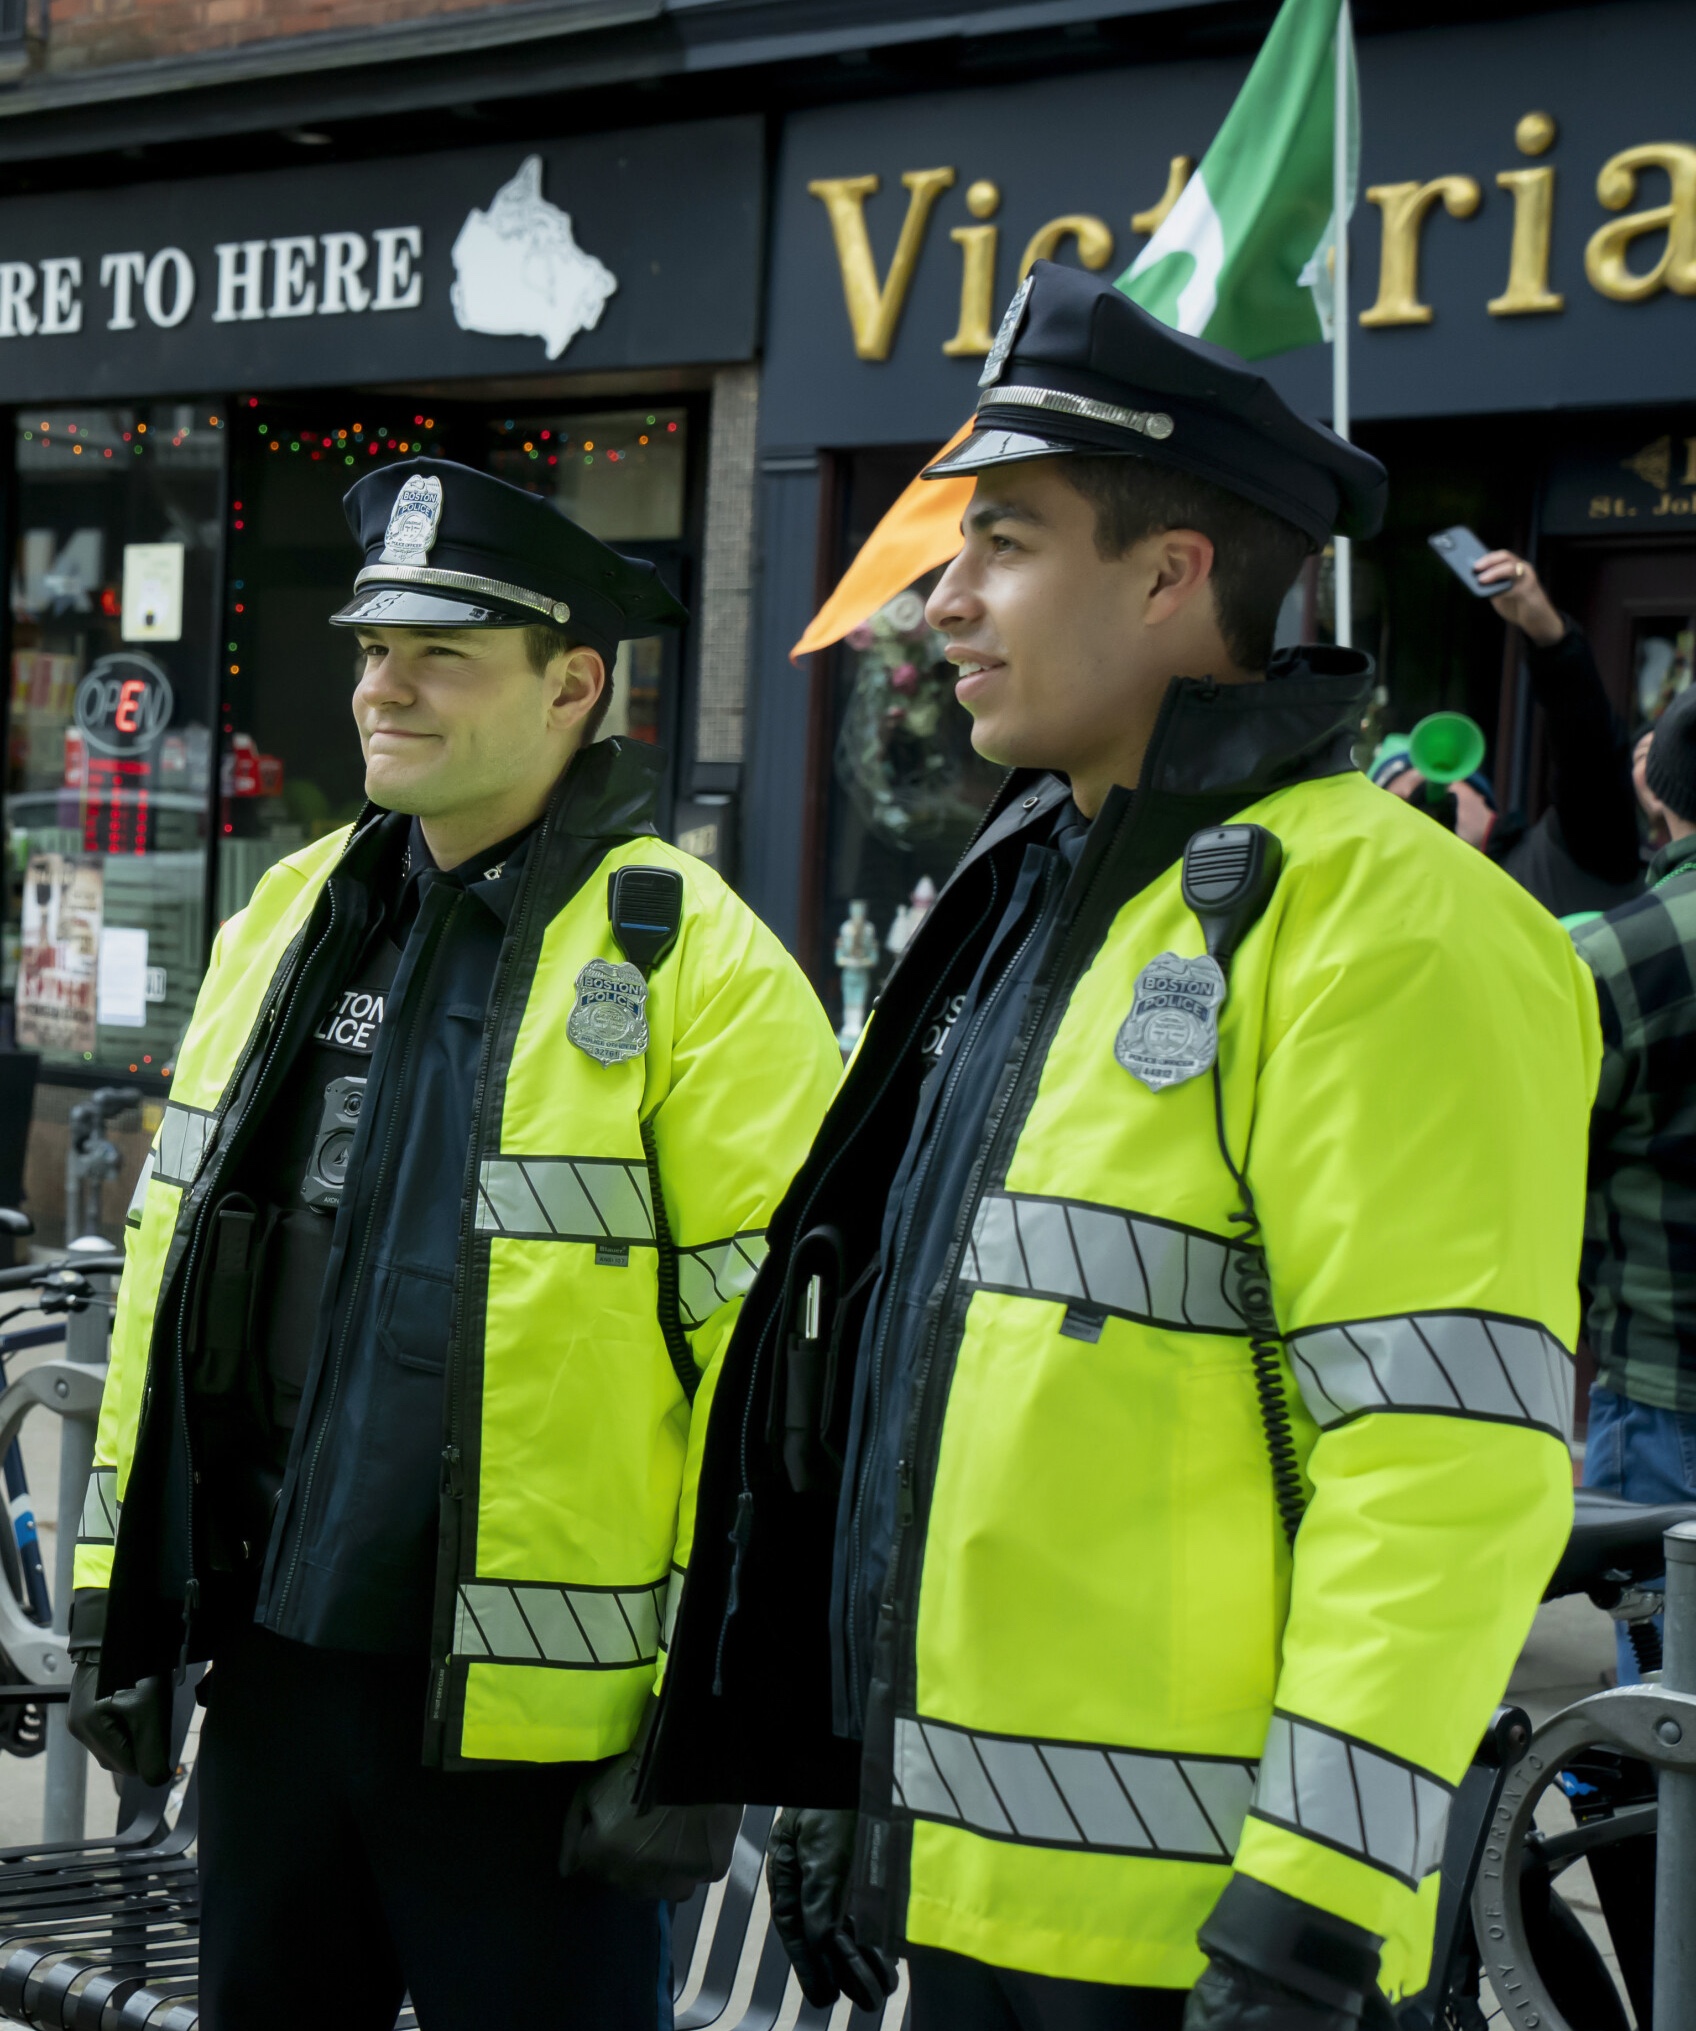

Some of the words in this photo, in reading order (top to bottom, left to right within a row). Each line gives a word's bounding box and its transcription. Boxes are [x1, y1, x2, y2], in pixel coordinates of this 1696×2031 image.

[807, 111, 1696, 361] Vicria
[100, 247, 195, 328] TO
[212, 226, 422, 322] HERE
[403, 491, 438, 503] BOSTON
[1588, 494, 1638, 518] St.
[401, 503, 431, 516] POLICE
[81, 675, 165, 733] OPEN
[584, 977, 641, 996] BOSTON
[1144, 977, 1214, 996] BOSTON
[586, 991, 636, 1012] POLICE
[1144, 995, 1203, 1018] POLICE
[1482, 1752, 1543, 1880] TORONTO
[1484, 1903, 1505, 1940] OF
[1497, 1963, 1541, 2030] CITY
